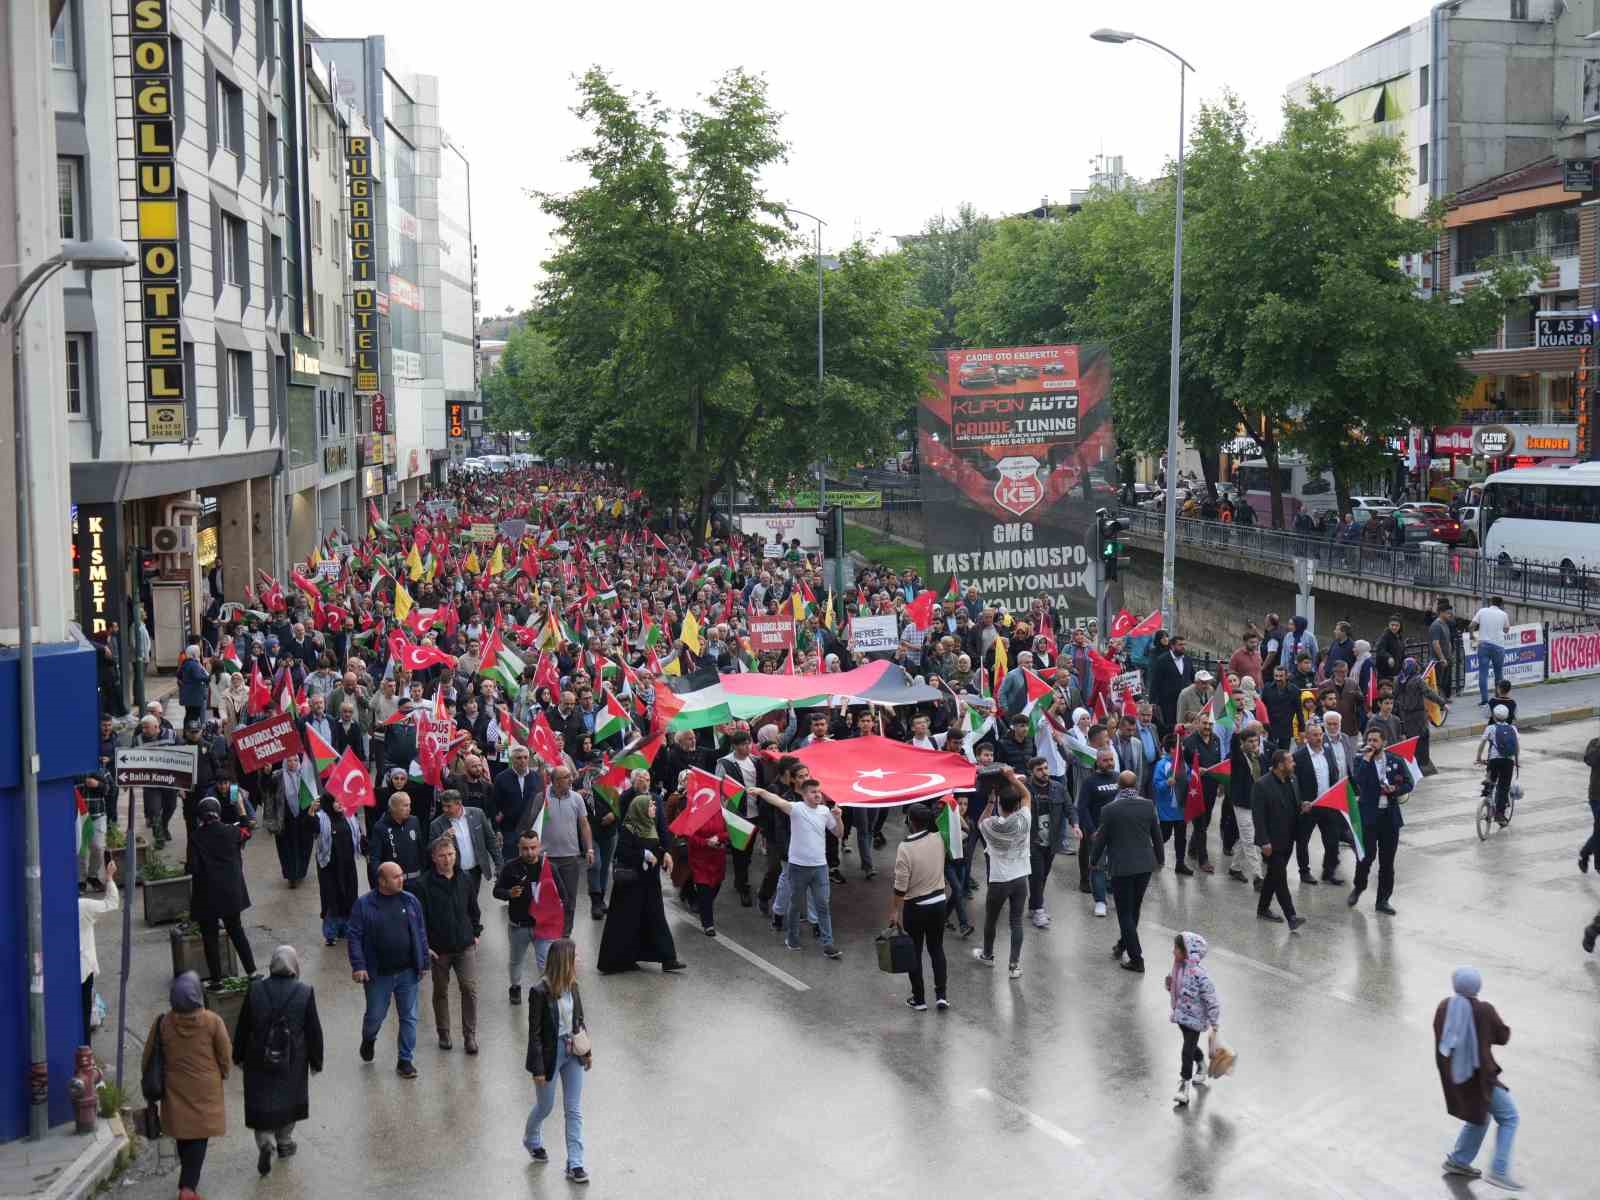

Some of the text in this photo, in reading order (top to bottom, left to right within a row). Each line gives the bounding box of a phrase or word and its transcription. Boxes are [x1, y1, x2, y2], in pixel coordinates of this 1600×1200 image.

[351, 138, 369, 279] RUGANCI
[145, 247, 180, 396] OTEL
[356, 291, 373, 369] OTEL
[1557, 320, 1575, 333] AS
[995, 352, 1012, 361] OTO
[1029, 395, 1078, 412] AUTO
[451, 404, 462, 437] FLO
[1014, 416, 1077, 433] TUNING
[993, 522, 1034, 544] GMG
[88, 516, 108, 613] KISMET
[932, 545, 1087, 574] KASTAMONUSPO
